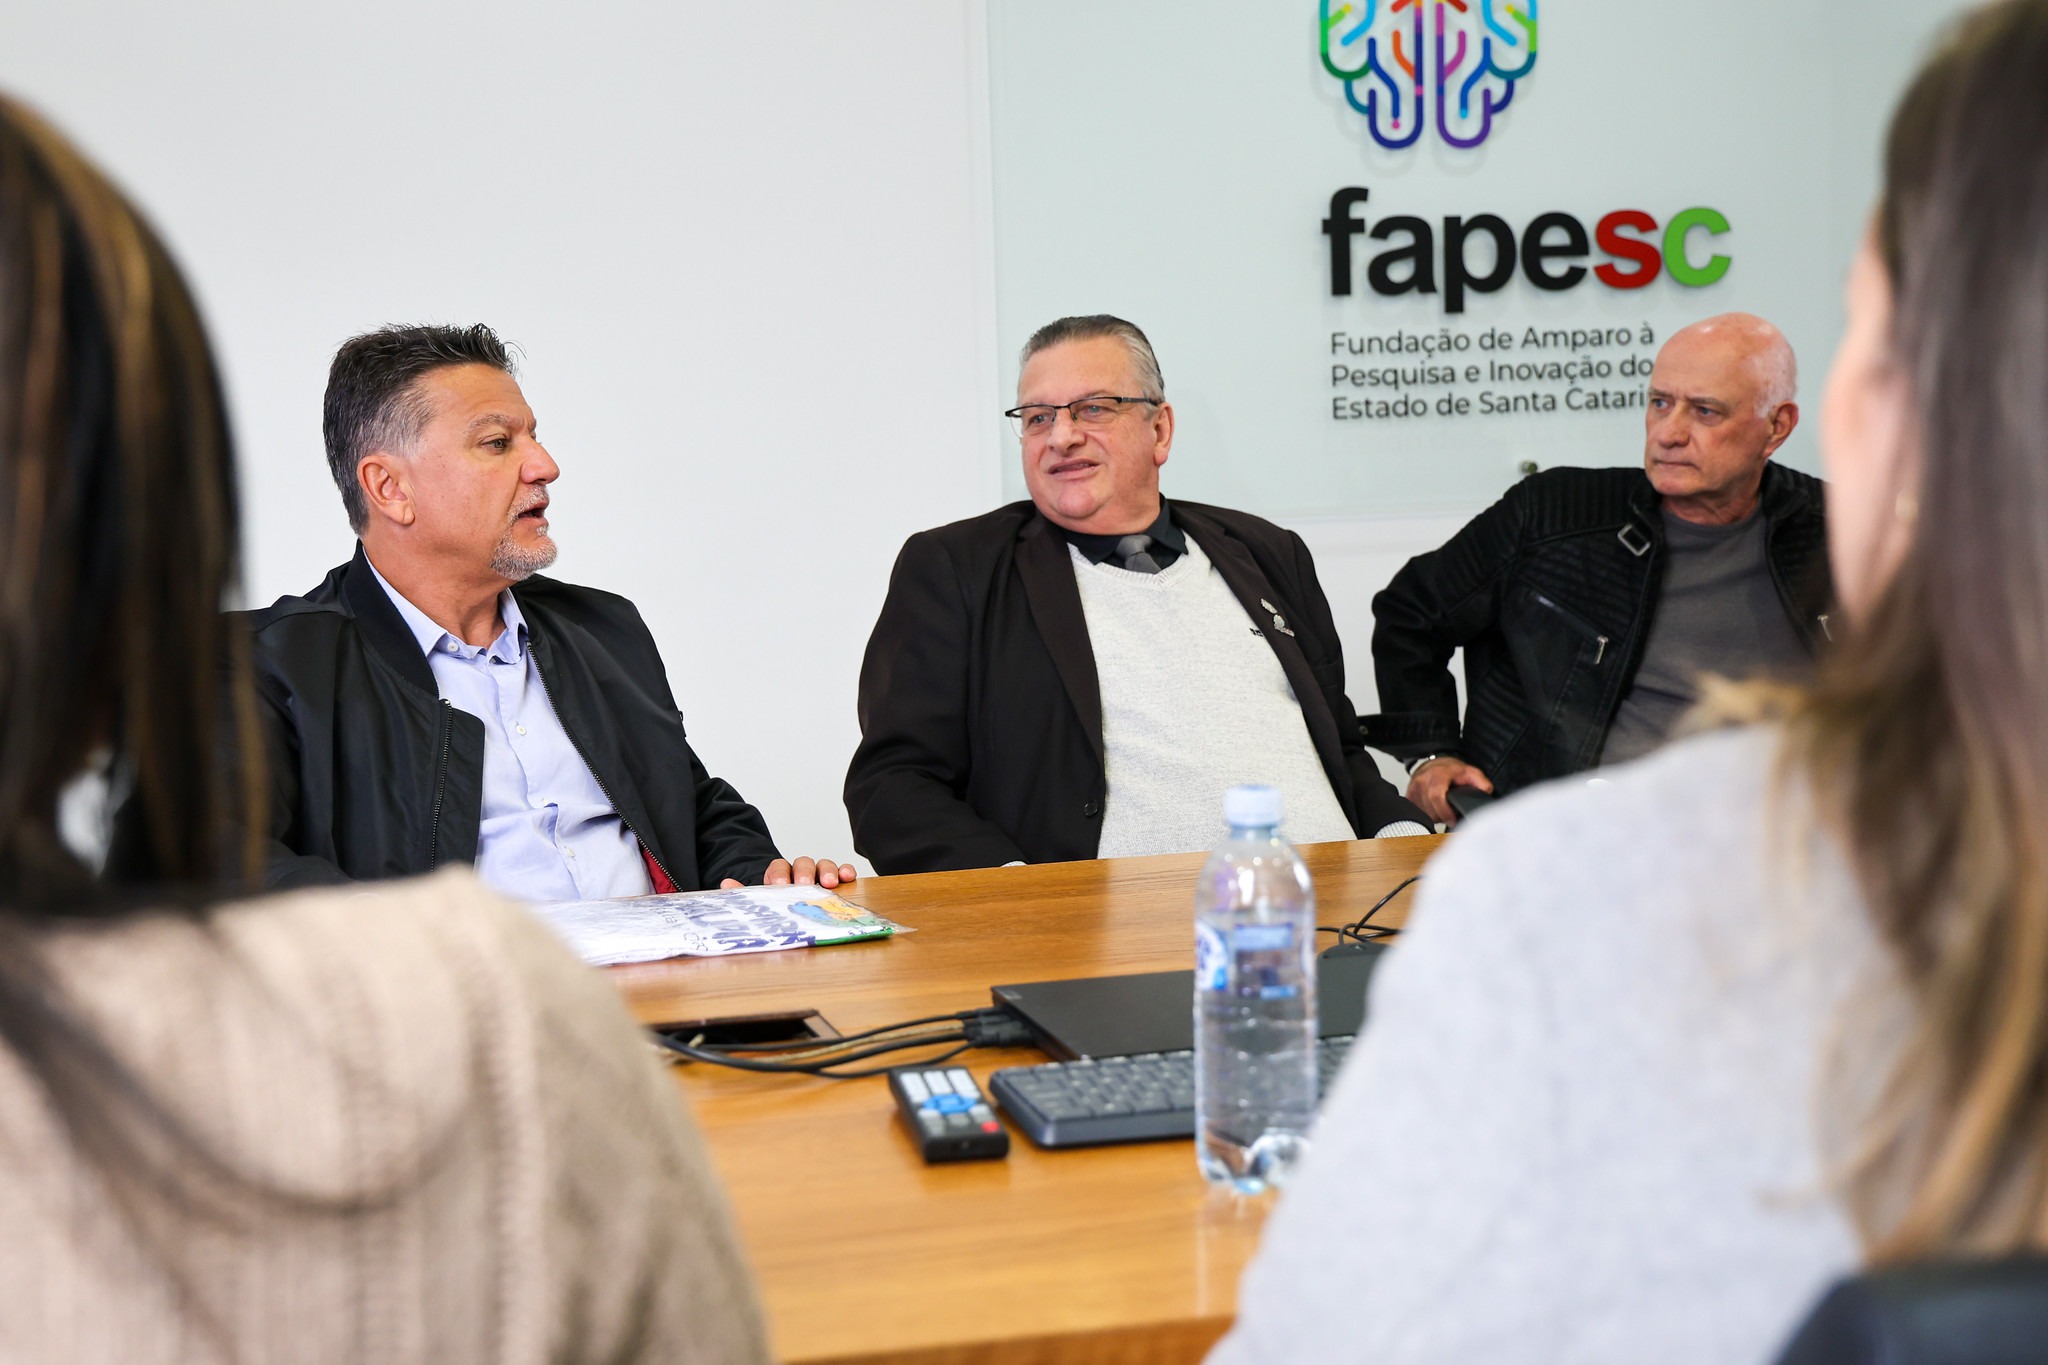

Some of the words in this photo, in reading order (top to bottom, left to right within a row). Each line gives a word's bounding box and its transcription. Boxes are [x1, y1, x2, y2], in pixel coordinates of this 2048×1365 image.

[1321, 187, 1732, 313] fapesc
[1331, 328, 1471, 359] Fundação
[1478, 326, 1514, 351] de
[1521, 325, 1632, 353] Amparo
[1640, 320, 1654, 345] à
[1332, 359, 1456, 391] Pesquisa
[1464, 364, 1480, 383] e
[1489, 354, 1613, 386] Inovação
[1619, 353, 1654, 378] do
[1332, 392, 1428, 420] Estado
[1435, 391, 1471, 417] de
[1478, 390, 1557, 416] Santa
[1565, 384, 1645, 411] Catari
